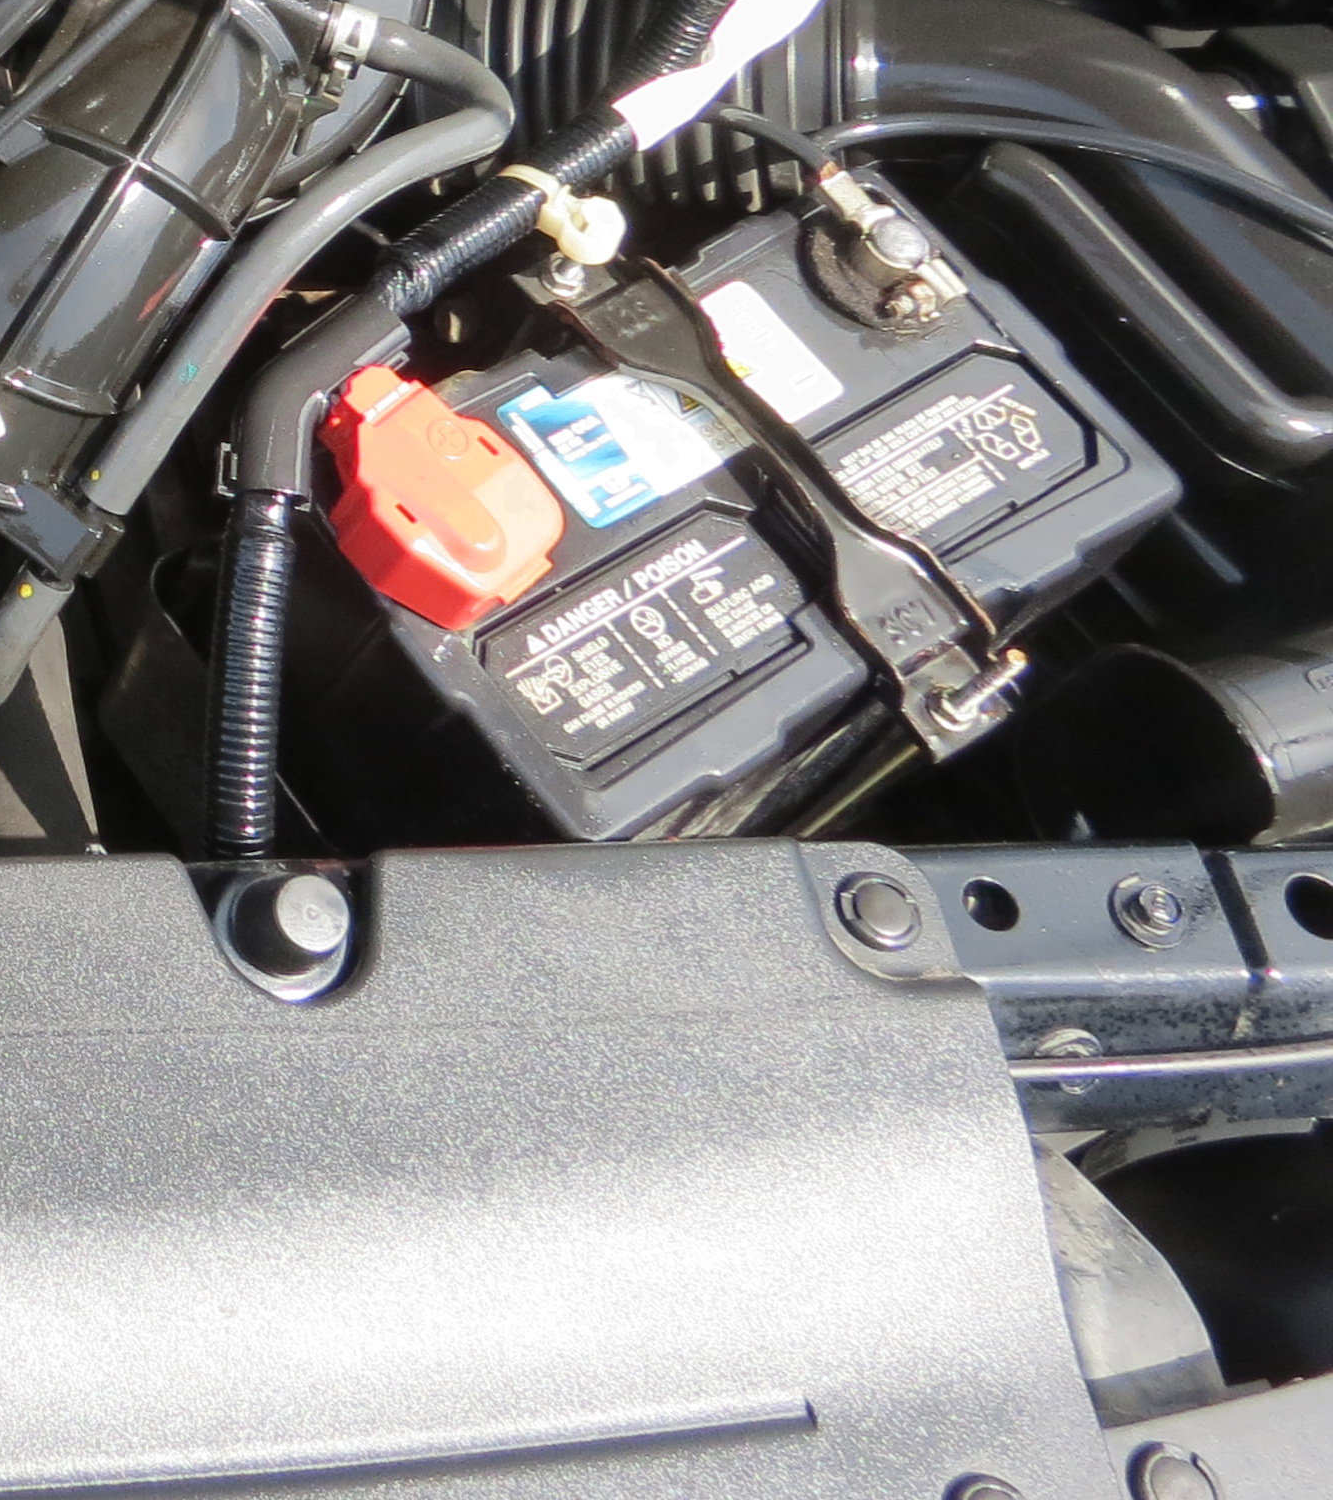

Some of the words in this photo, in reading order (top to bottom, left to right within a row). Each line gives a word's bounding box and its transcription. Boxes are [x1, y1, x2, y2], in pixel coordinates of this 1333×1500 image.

[541, 588, 624, 643] DANGER
[623, 578, 632, 600] /
[633, 539, 708, 590] POISON
[570, 634, 610, 663] SHIELD
[580, 651, 610, 674] EYES
[567, 658, 625, 698] EXPLOSIVE
